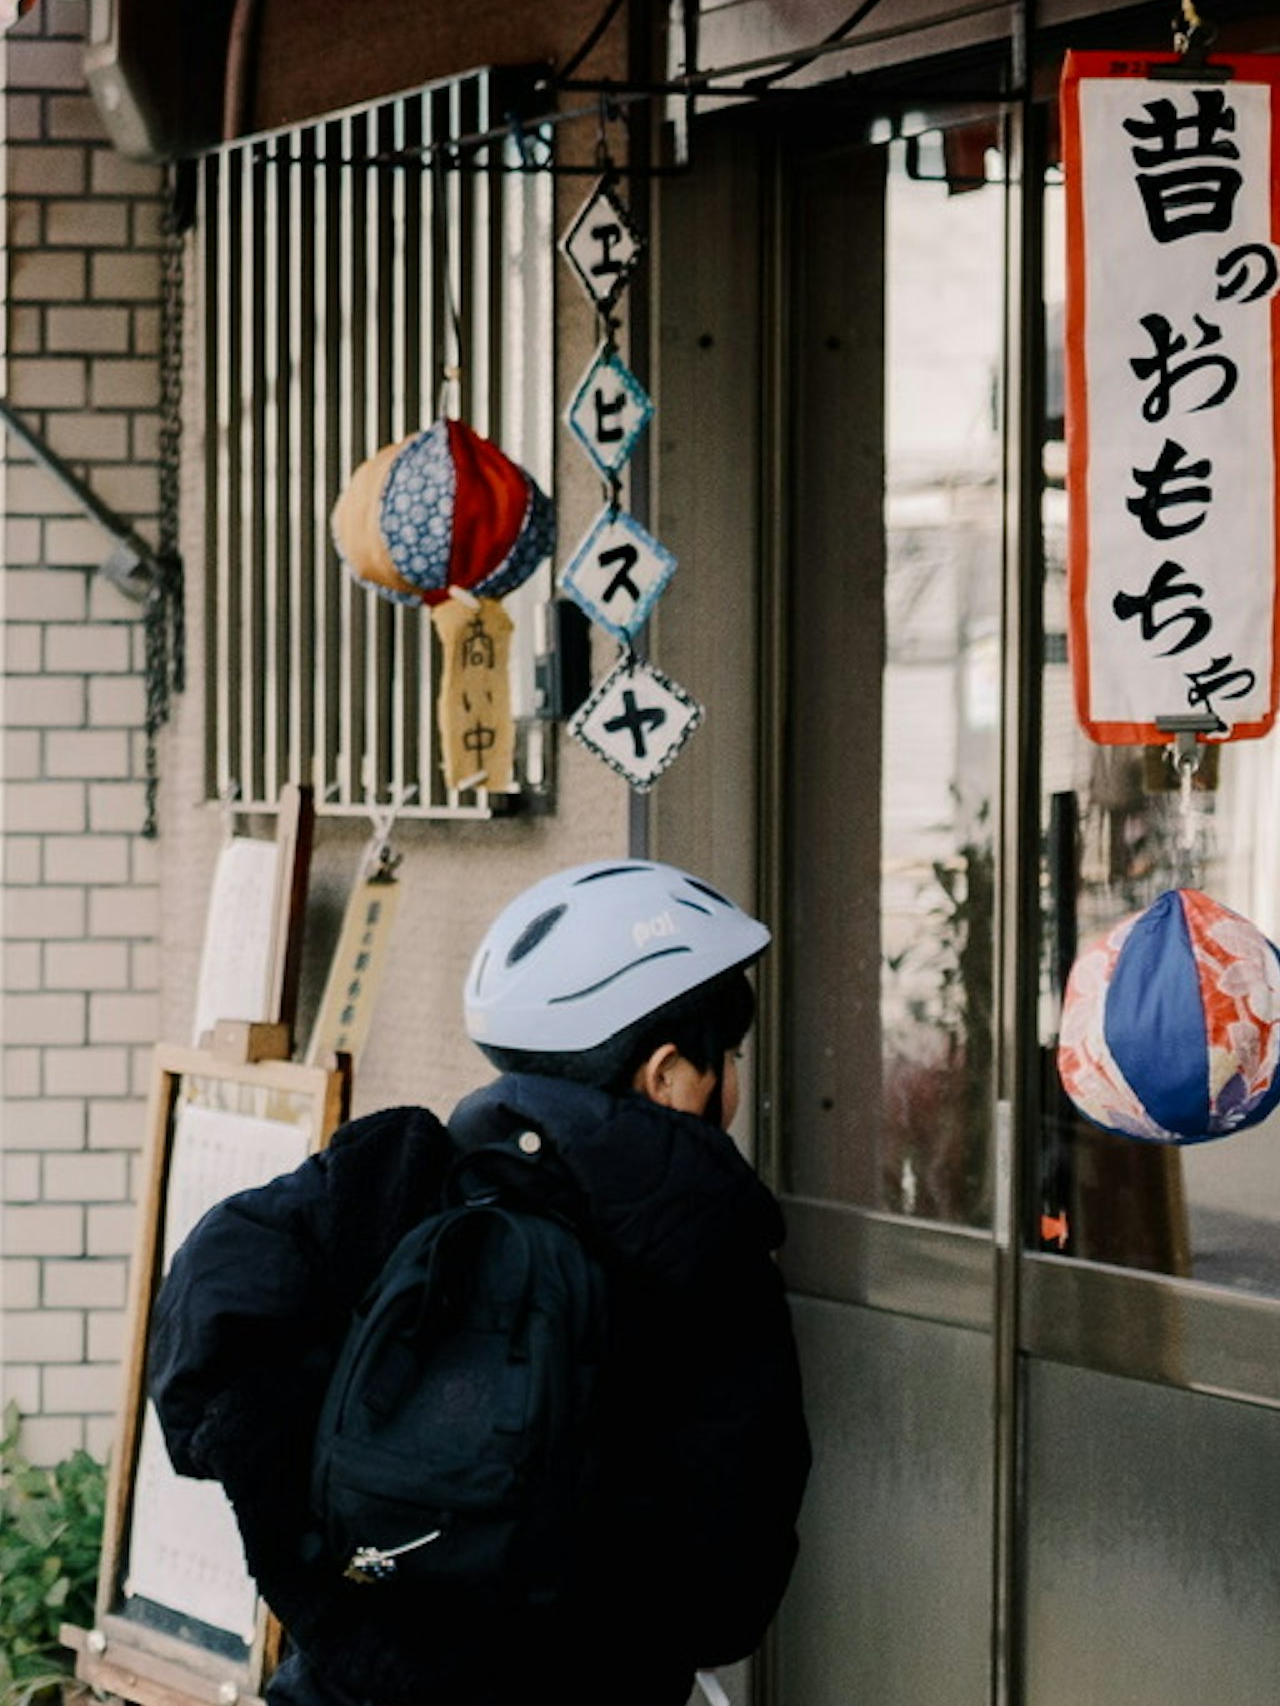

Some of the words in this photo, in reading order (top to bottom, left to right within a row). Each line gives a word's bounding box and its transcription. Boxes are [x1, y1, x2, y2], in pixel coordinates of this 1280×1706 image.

[1113, 90, 1280, 733] 昔のおもちゃ
[460, 617, 496, 771] 商い中
